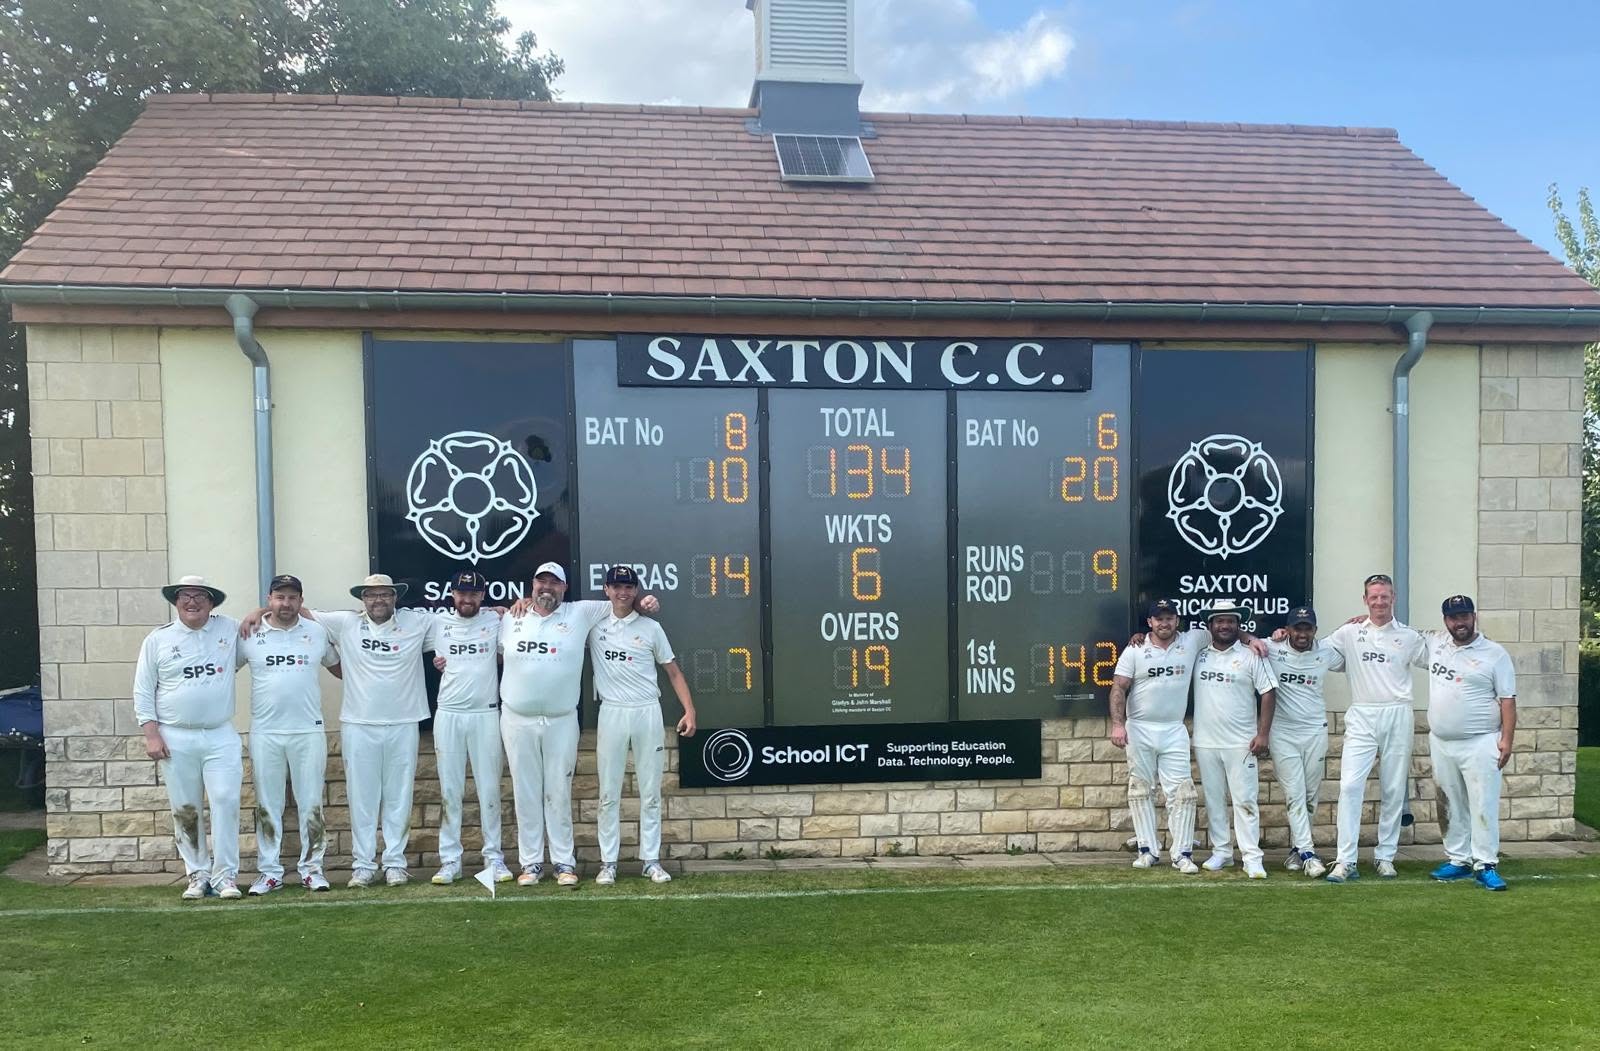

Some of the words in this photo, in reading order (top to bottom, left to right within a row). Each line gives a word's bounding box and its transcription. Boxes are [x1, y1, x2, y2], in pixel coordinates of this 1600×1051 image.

[646, 336, 916, 384] SAXTON
[940, 341, 1065, 386] C.C.
[585, 416, 629, 446] BAT
[635, 417, 664, 446] No
[724, 411, 748, 451] 8
[820, 407, 895, 437] TOTAL
[965, 418, 1007, 447] BAT
[1012, 419, 1039, 447] No
[1097, 412, 1119, 450] 6
[708, 456, 749, 504] 10
[829, 443, 912, 500] 134
[1061, 456, 1119, 502] 20
[824, 513, 893, 544] WKTS
[850, 546, 883, 601] 6
[965, 544, 1025, 573] RUNS
[1092, 548, 1119, 593] 9
[423, 580, 525, 601] SAON
[589, 562, 679, 591] ERAS
[709, 555, 751, 597] 14
[966, 575, 1012, 605] RQD
[1179, 574, 1268, 594] SAXTON
[1169, 598, 1237, 616] RICK
[1241, 597, 1290, 615] CLUB
[820, 612, 900, 642] OVERS
[851, 645, 891, 688] 19
[966, 638, 996, 666] 1st
[1046, 641, 1118, 687] 142
[728, 647, 752, 691] 7
[966, 667, 1016, 695] INNS
[761, 744, 830, 765] School
[836, 743, 869, 763] ICT
[877, 757, 907, 767] Data.
[909, 755, 973, 768] Technology.
[975, 754, 1016, 767] People.
[886, 742, 949, 755] Supporting
[951, 740, 1007, 751] Education
